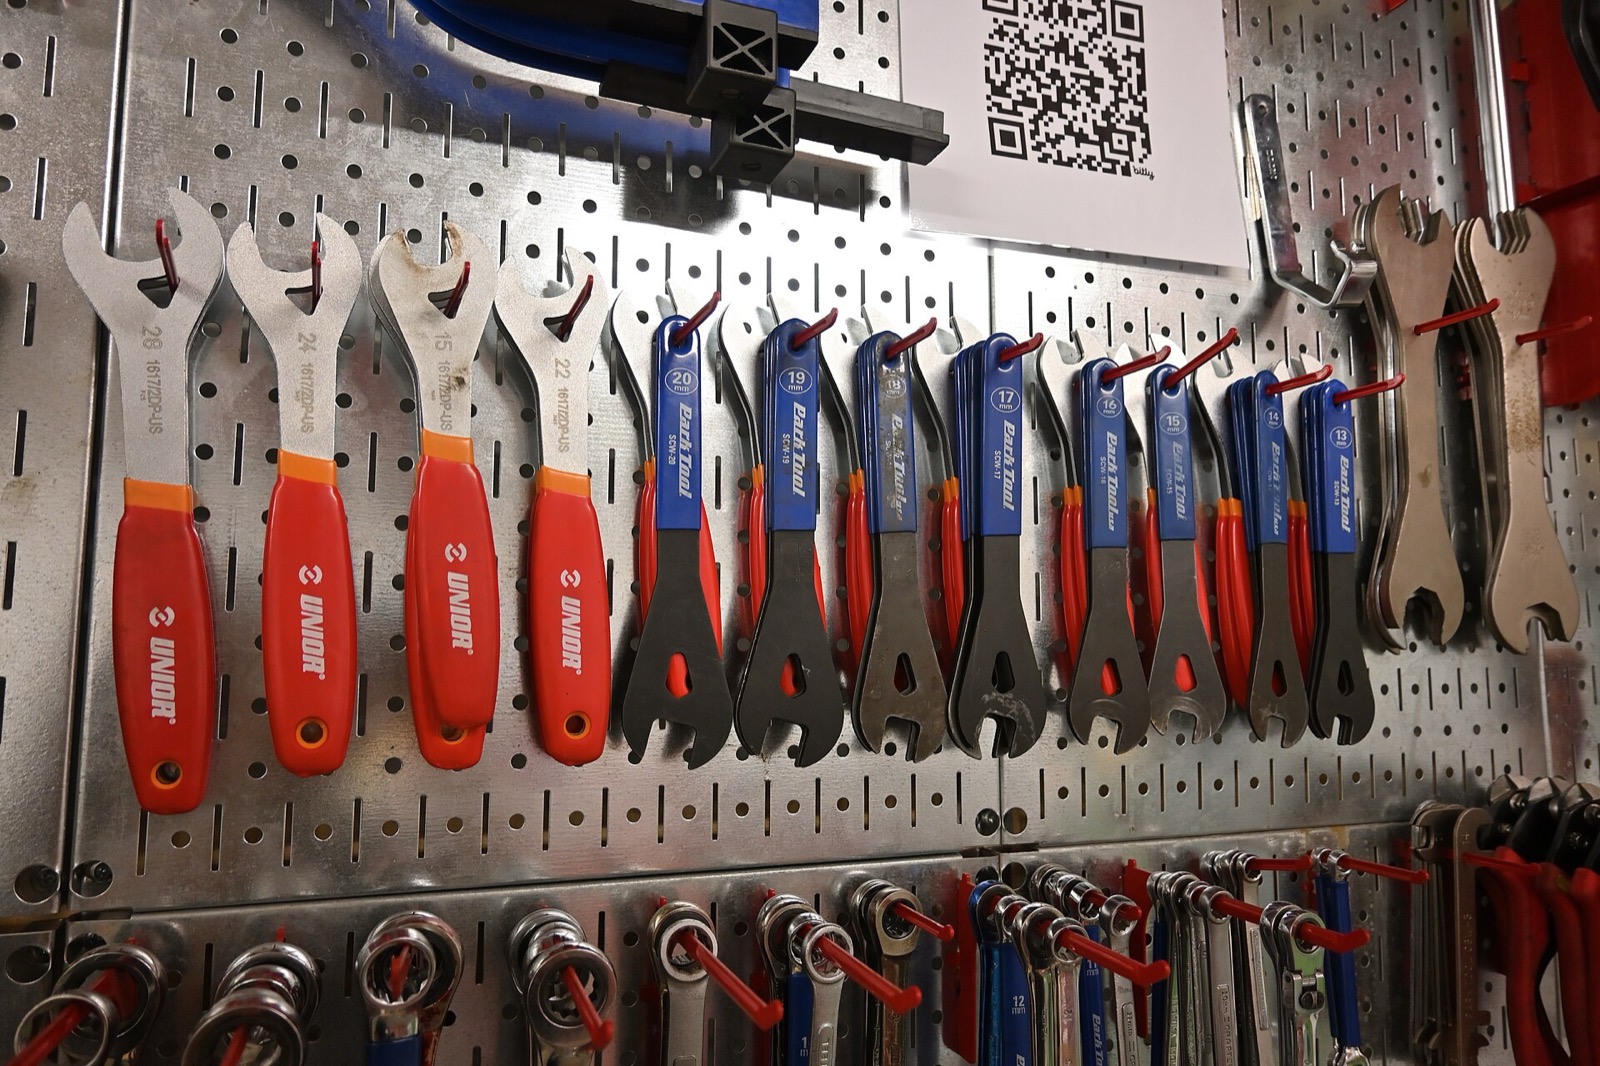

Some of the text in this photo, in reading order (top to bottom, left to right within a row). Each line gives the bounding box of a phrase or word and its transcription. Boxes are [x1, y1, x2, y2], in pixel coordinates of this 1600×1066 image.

[435, 332, 452, 351] 15
[142, 326, 164, 435] 28 1617/2DP-US
[298, 332, 317, 434] 24 1617/2DP-US
[672, 371, 692, 385] 20
[787, 371, 805, 384] 19
[554, 358, 571, 453] 22 1617/2DP-US
[998, 391, 1014, 403] 17
[1102, 400, 1117, 409] 16
[1166, 415, 1180, 427] 15
[1268, 412, 1279, 421] 14
[668, 434, 676, 465] SCW-20
[678, 402, 692, 499] Park Tool
[782, 433, 790, 464] SCW-19
[792, 401, 806, 497] Park Tool
[1106, 431, 1118, 476] Park
[1335, 430, 1347, 441] 13
[993, 450, 1001, 479] SCW-17
[1003, 419, 1015, 511] Park Tool
[1165, 468, 1173, 494] SCW-15
[1107, 475, 1119, 515] Tool
[1340, 454, 1351, 533] Park Tool
[447, 571, 473, 650] UNIOR
[300, 593, 325, 675] UNIOR
[561, 595, 582, 670] UNIOR
[150, 637, 176, 719] UNIOR
[1011, 1006, 1026, 1015] mm
[1012, 995, 1025, 1007] 12
[1092, 1013, 1103, 1050] Park
[1224, 1024, 1233, 1066] CRAFTS
